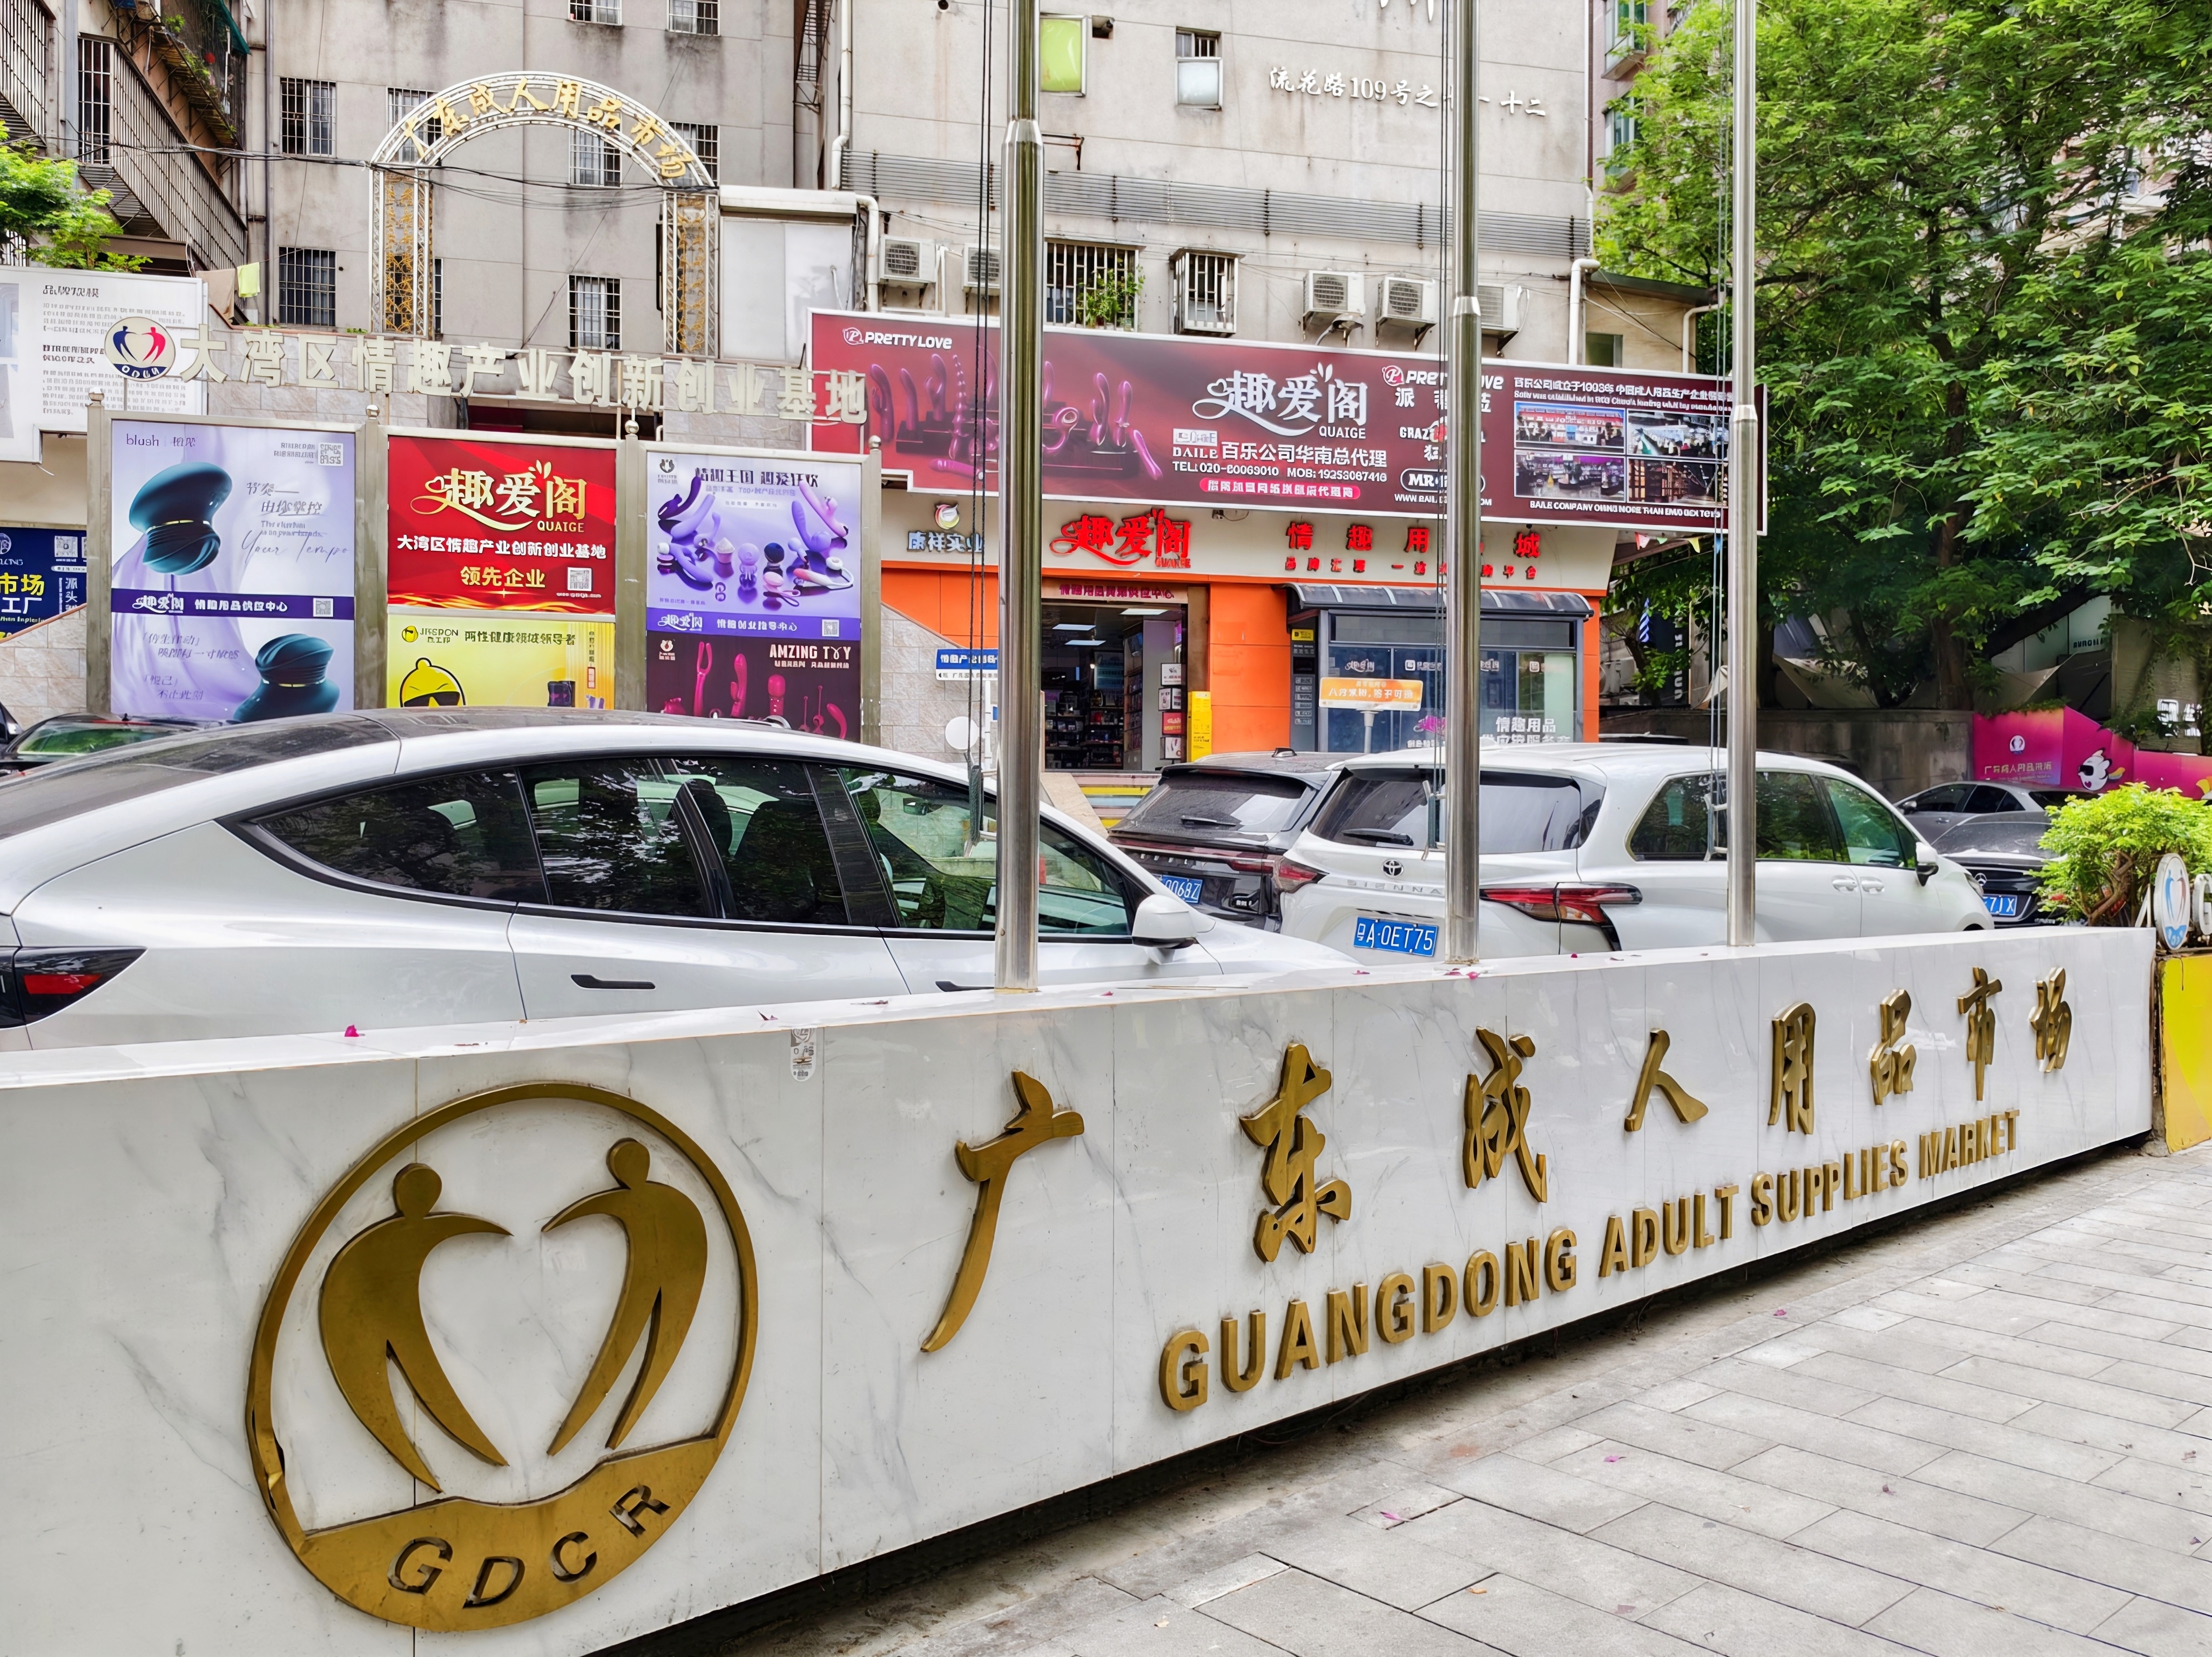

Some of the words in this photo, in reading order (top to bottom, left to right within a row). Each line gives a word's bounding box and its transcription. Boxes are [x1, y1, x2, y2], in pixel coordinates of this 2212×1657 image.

[180, 324, 867, 425] 大湾区情趣产业创新创业基地
[1192, 362, 1368, 436] 趣爱阁
[126, 433, 159, 447] blush
[1318, 426, 1366, 439] QUAIGE
[1221, 441, 1387, 468] 百乐公司华南总代理
[410, 459, 587, 531] 趣爱阁
[536, 520, 584, 533] QUAIGE
[460, 565, 546, 588] 领先企业
[1, 596, 43, 615] 工厂
[769, 644, 818, 659] AMZING
[920, 967, 2073, 1352] 广东成人用品市场
[1158, 1228, 1578, 1412] GUANGDONG
[1599, 1184, 1740, 1279] ADULT
[1750, 1139, 1909, 1227] SUPPLIES
[1919, 1109, 2021, 1180] MARKET
[386, 1483, 672, 1610] GDCR
